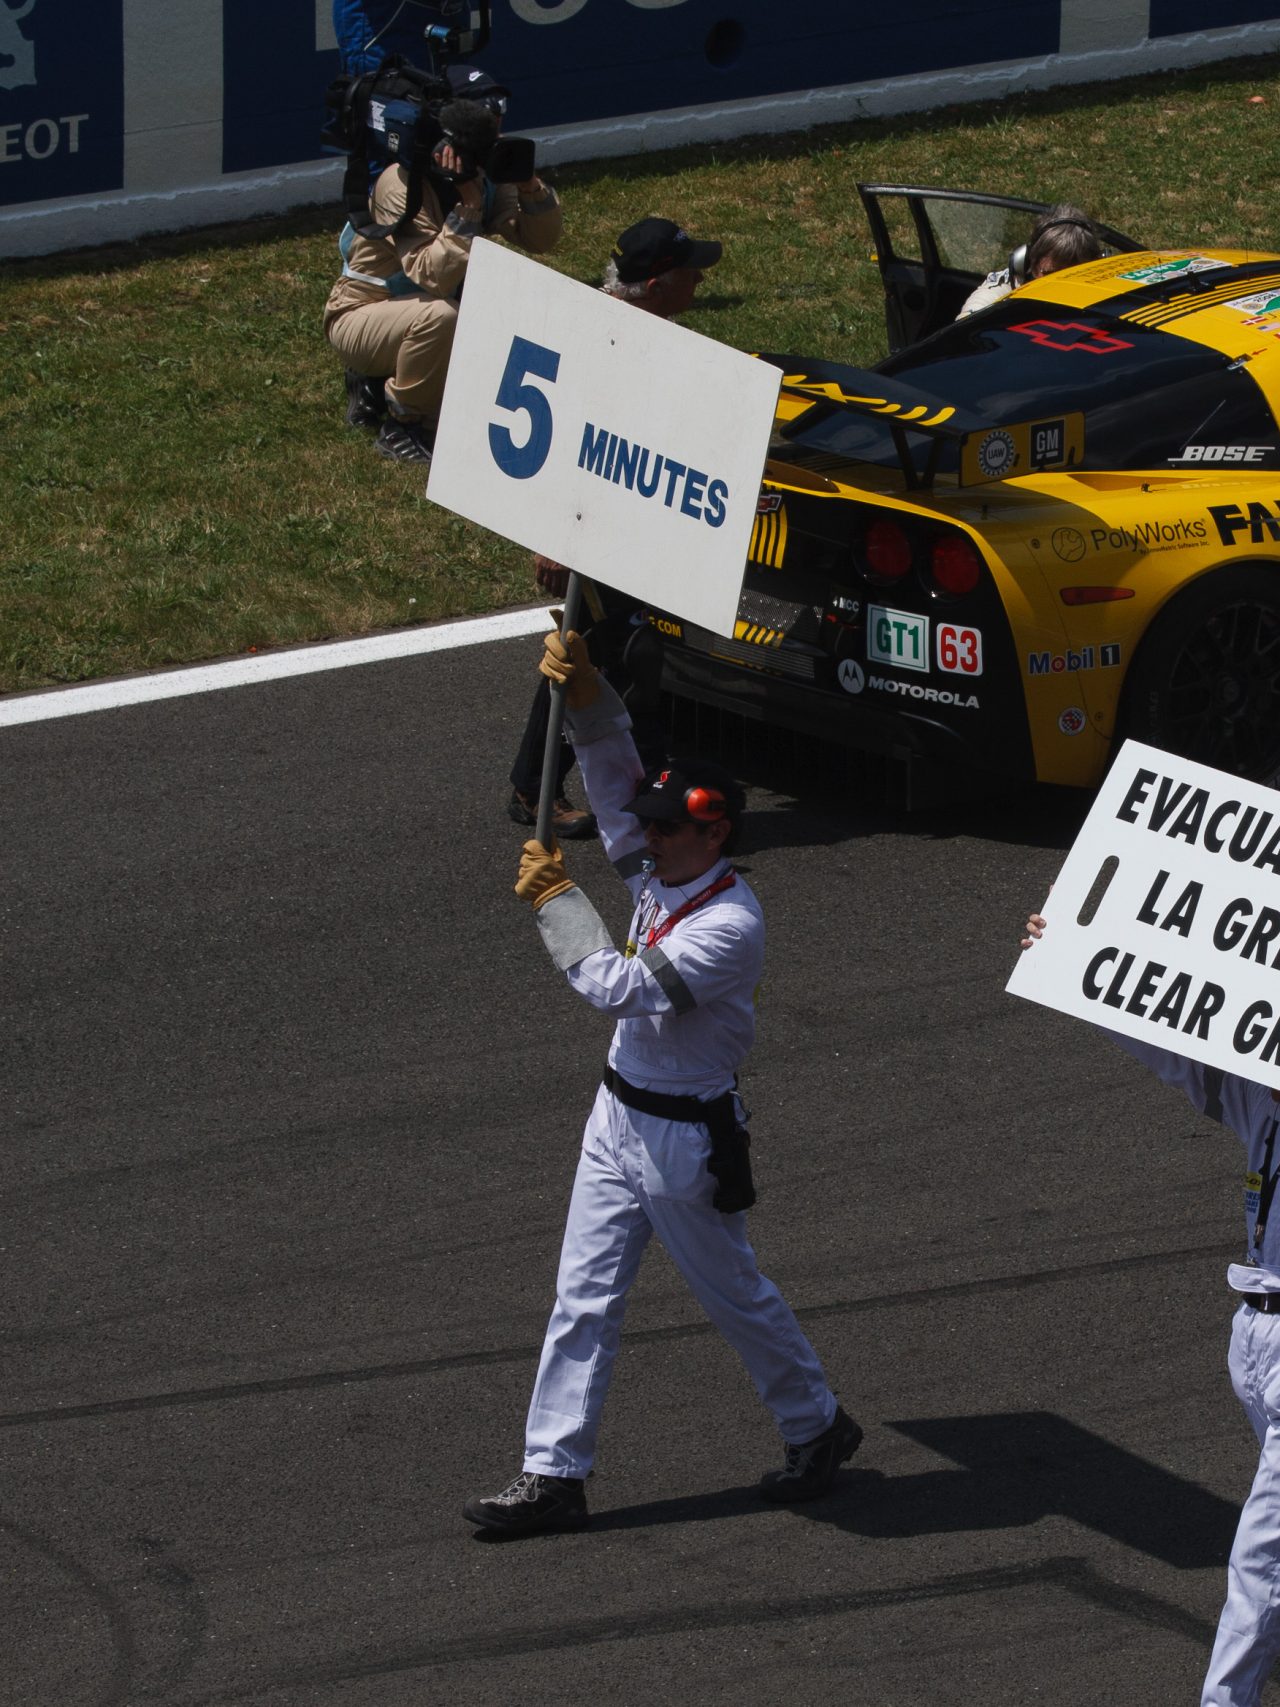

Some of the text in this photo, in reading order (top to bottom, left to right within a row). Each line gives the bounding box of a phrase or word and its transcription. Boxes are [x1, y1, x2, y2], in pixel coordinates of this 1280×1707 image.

[488, 335, 729, 529] 5 MINUTES
[1036, 428, 1059, 453] GM
[1167, 445, 1276, 463] BOSE
[876, 618, 919, 660] GT1
[940, 626, 978, 673] 63
[1028, 647, 1094, 675] Mobil
[868, 675, 980, 710] MOTOROLA
[1135, 869, 1204, 939] LA
[1081, 946, 1227, 1041] CLEAR
